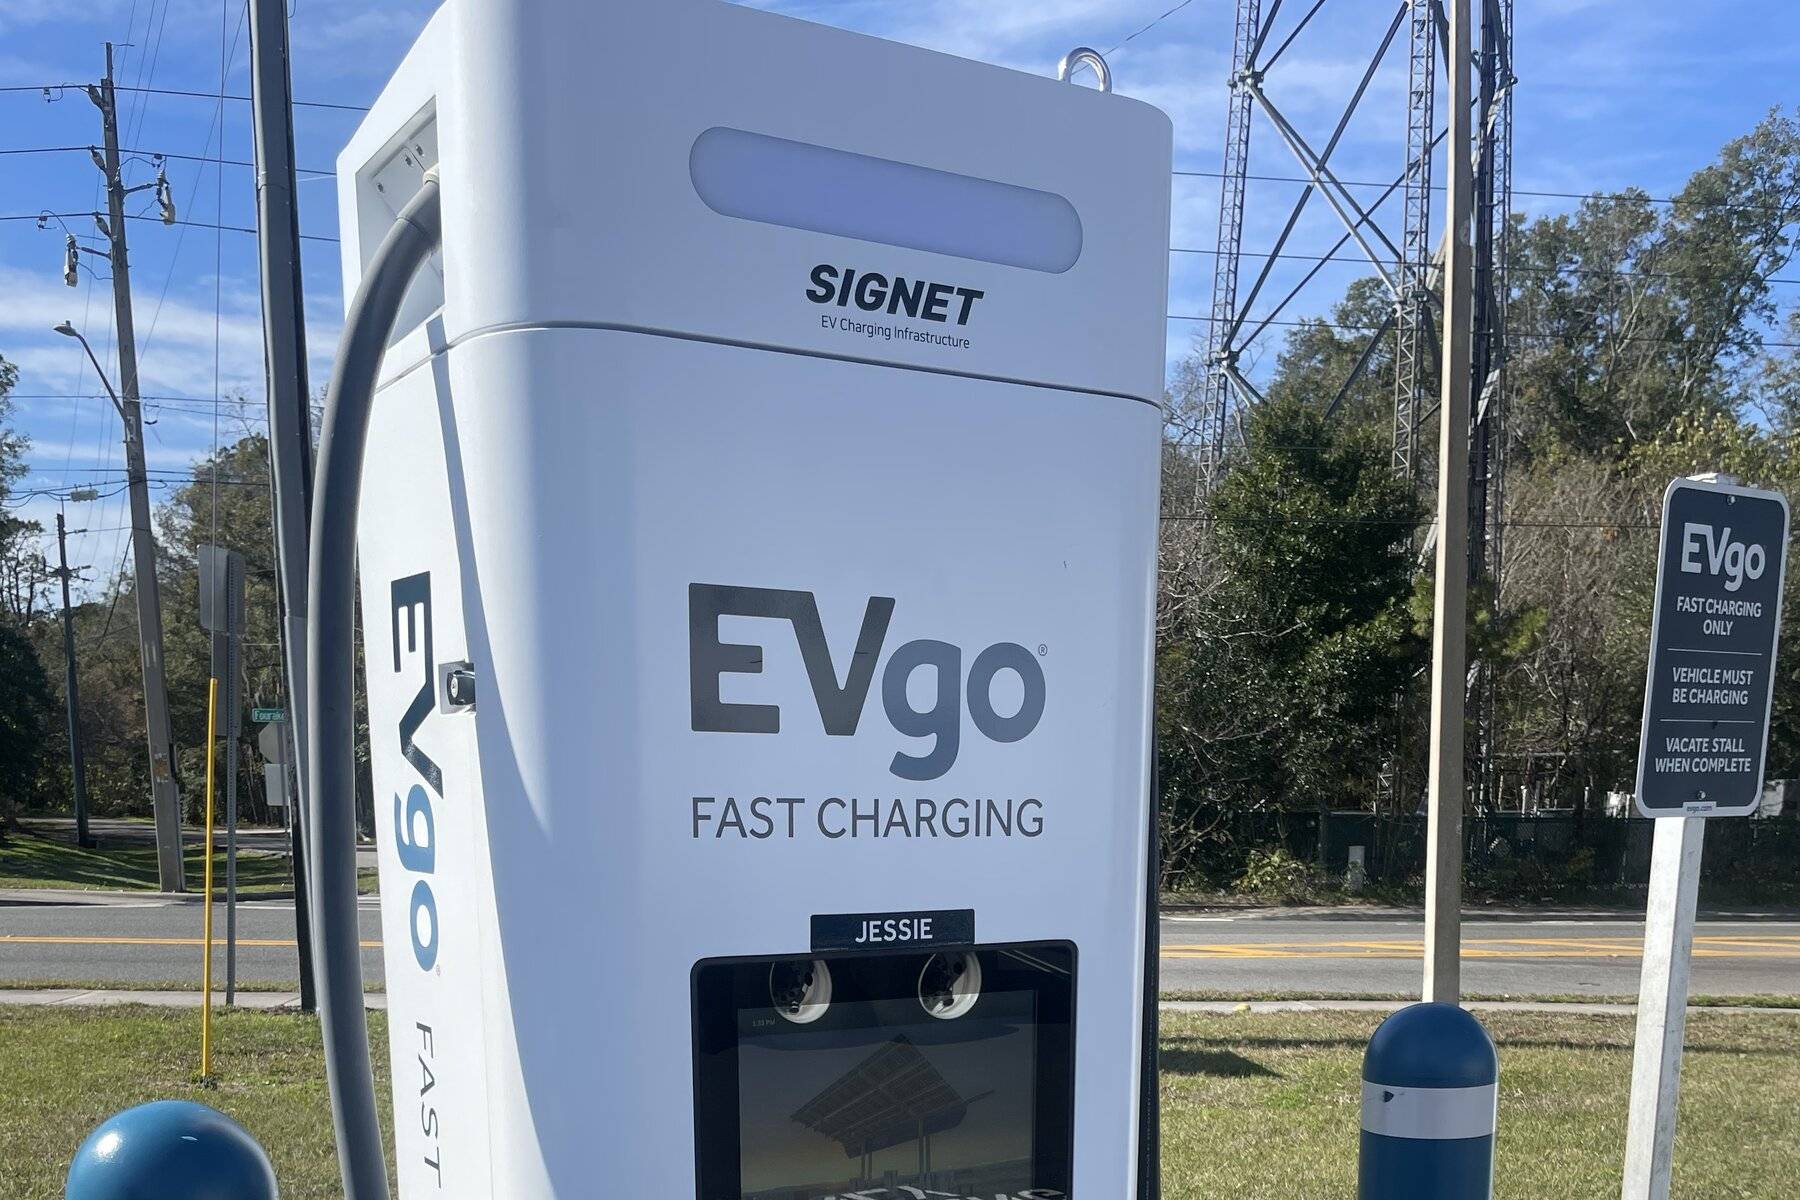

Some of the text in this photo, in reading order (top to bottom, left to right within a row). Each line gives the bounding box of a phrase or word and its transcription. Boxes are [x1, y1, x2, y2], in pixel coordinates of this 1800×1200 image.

[805, 264, 985, 326] SIGNET
[822, 315, 970, 349] EV Charging Infrastructure
[1680, 522, 1766, 592] EVgo
[1677, 596, 1762, 618] FAST CHARGING
[1703, 620, 1733, 636] ONLY
[689, 583, 1047, 781] EVgo
[1672, 667, 1754, 686] VEHICLE MUST
[1672, 688, 1749, 706] BE CHARGING
[1666, 737, 1745, 754] VACATE STALL
[391, 571, 444, 971] EVgo
[1655, 757, 1752, 773] WHEN COMPLETE
[692, 797, 1044, 839] FAST CHARGING
[855, 918, 933, 943] JESSIE
[416, 1020, 442, 1189] FAST
